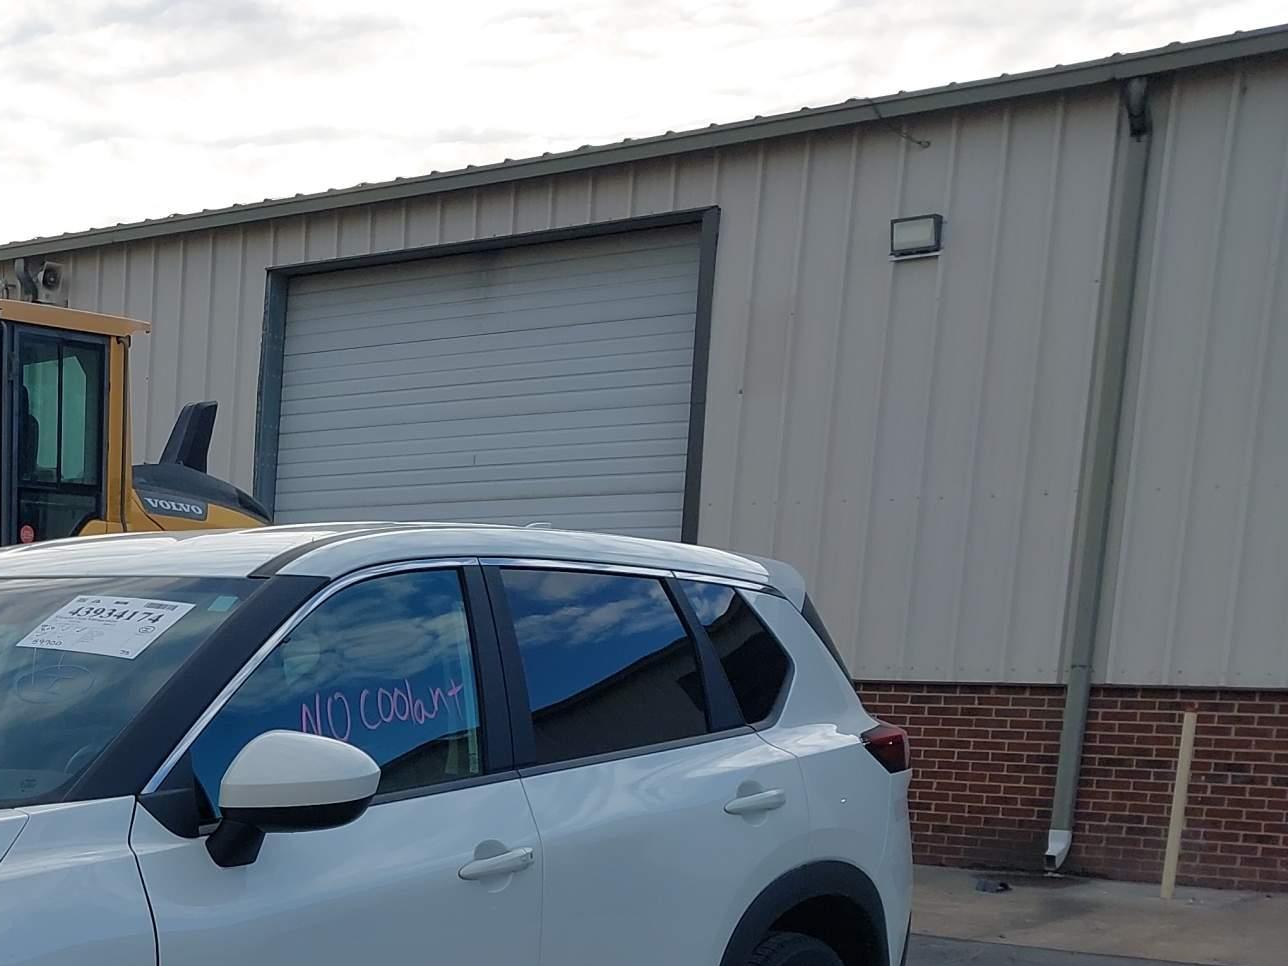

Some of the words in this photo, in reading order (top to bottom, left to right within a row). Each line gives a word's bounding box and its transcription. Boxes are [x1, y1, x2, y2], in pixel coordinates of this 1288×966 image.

[144, 497, 203, 515] VOLVO
[69, 606, 164, 624] 43934174
[301, 692, 351, 742] NO
